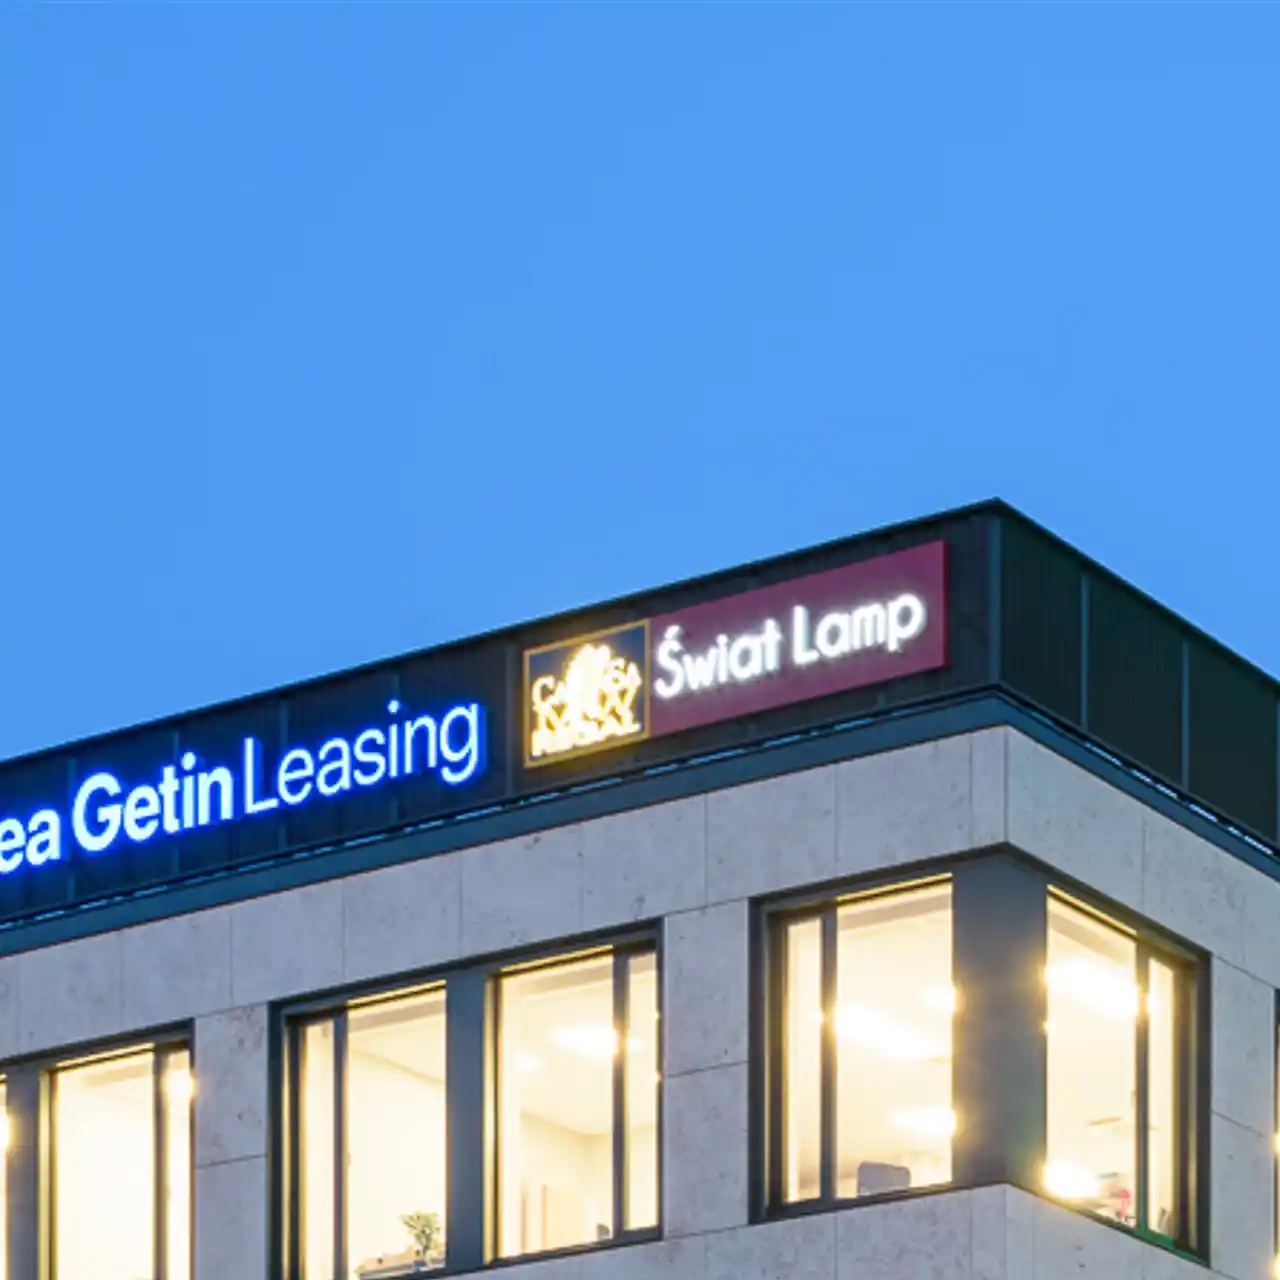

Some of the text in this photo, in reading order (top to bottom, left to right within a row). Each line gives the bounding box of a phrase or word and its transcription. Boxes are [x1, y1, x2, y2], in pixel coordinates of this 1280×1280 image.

[654, 592, 927, 698] Świat Lamp
[72, 751, 234, 852] Getin
[243, 698, 481, 815] Leasing
